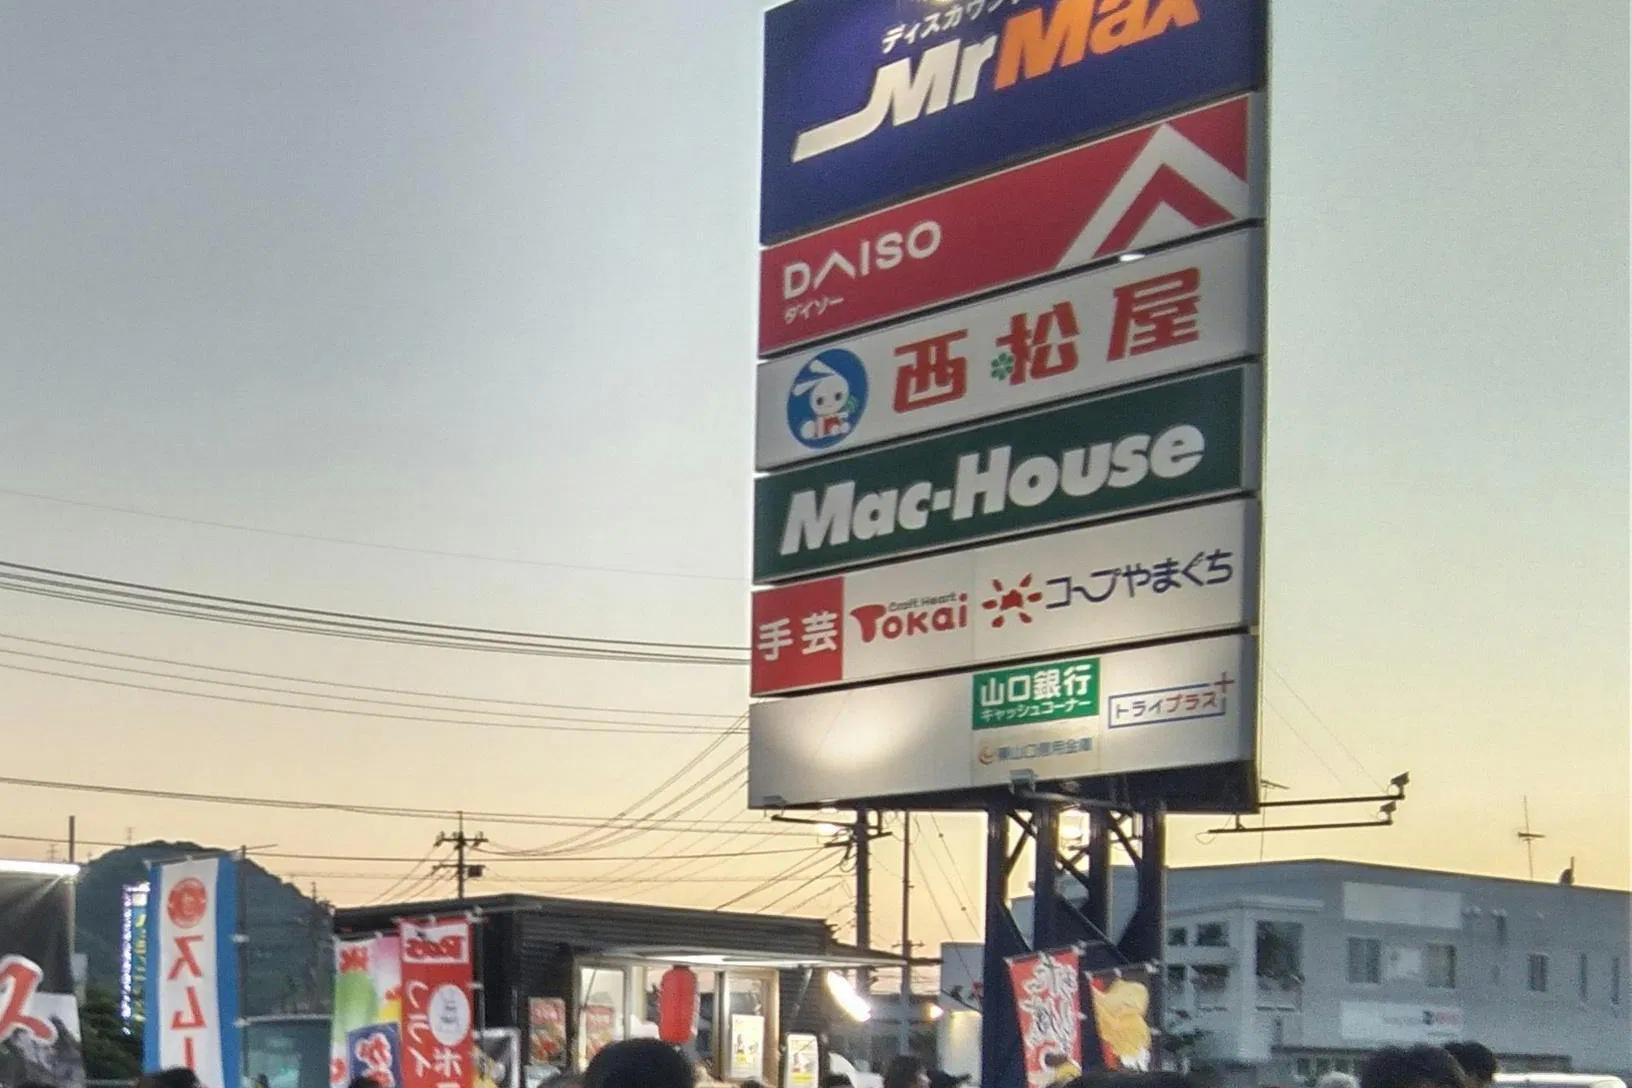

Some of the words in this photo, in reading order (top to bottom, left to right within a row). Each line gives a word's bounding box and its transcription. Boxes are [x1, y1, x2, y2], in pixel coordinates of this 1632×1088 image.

[882, 0, 1021, 54] ディスカウ
[784, 220, 942, 300] DAISO
[784, 296, 844, 325] ダイソー
[893, 267, 1200, 414] 西松屋
[780, 424, 1205, 556] Mac-House
[1046, 549, 1234, 609] コープやまぐち
[757, 610, 841, 662] 手芸
[980, 664, 1092, 707] 山口銀行
[980, 698, 1092, 722] キャッシュコーナー
[1116, 691, 1217, 719] トライプラス
